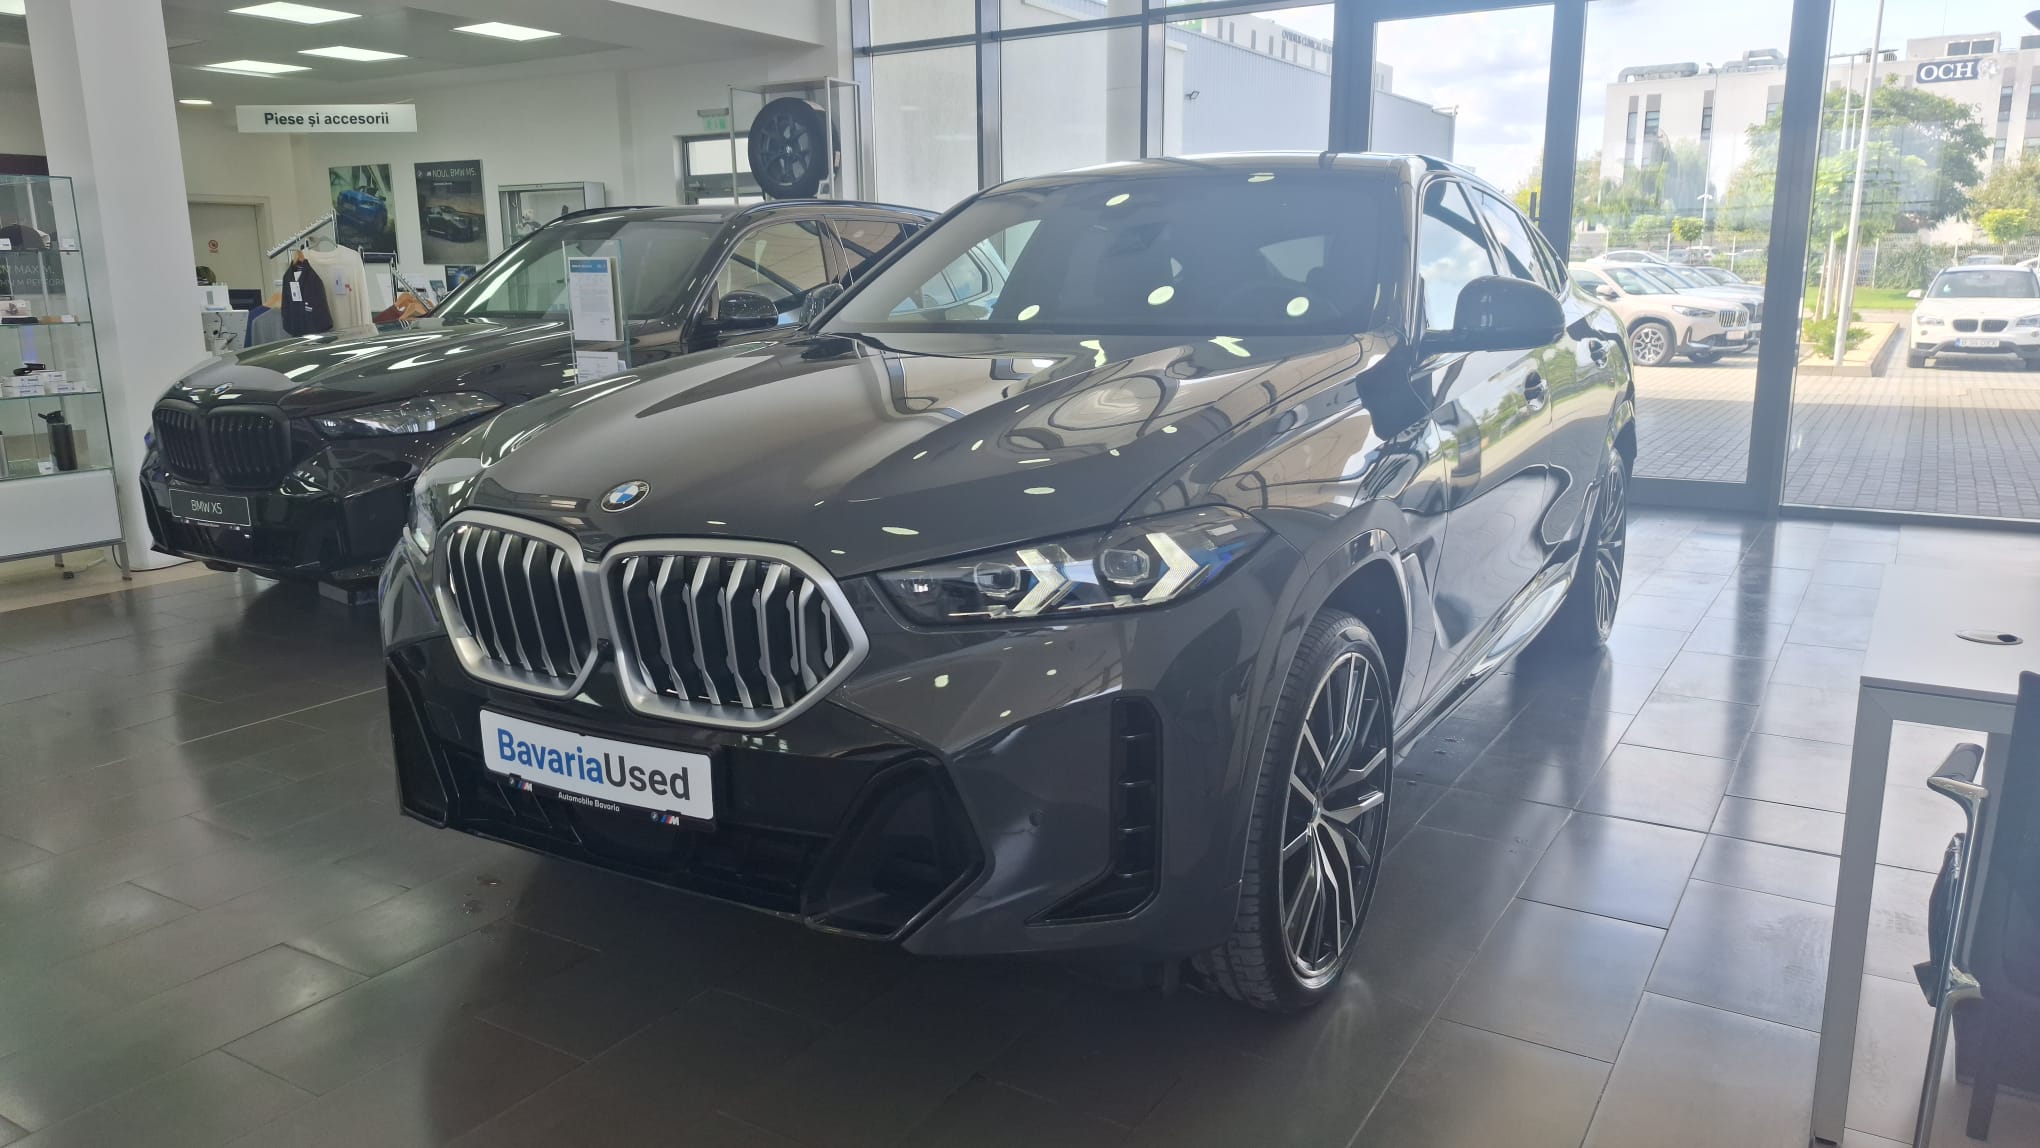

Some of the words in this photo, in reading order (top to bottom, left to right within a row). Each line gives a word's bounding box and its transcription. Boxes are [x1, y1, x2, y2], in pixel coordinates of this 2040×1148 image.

[1920, 62, 1975, 81] OCH
[264, 112, 304, 125] Piese
[324, 111, 389, 125] accesorii
[191, 499, 210, 513] BMW
[211, 502, 223, 515] X5
[497, 728, 691, 801] BavariaUsed
[558, 791, 594, 806] Automobile
[594, 799, 620, 812] Bavaria
